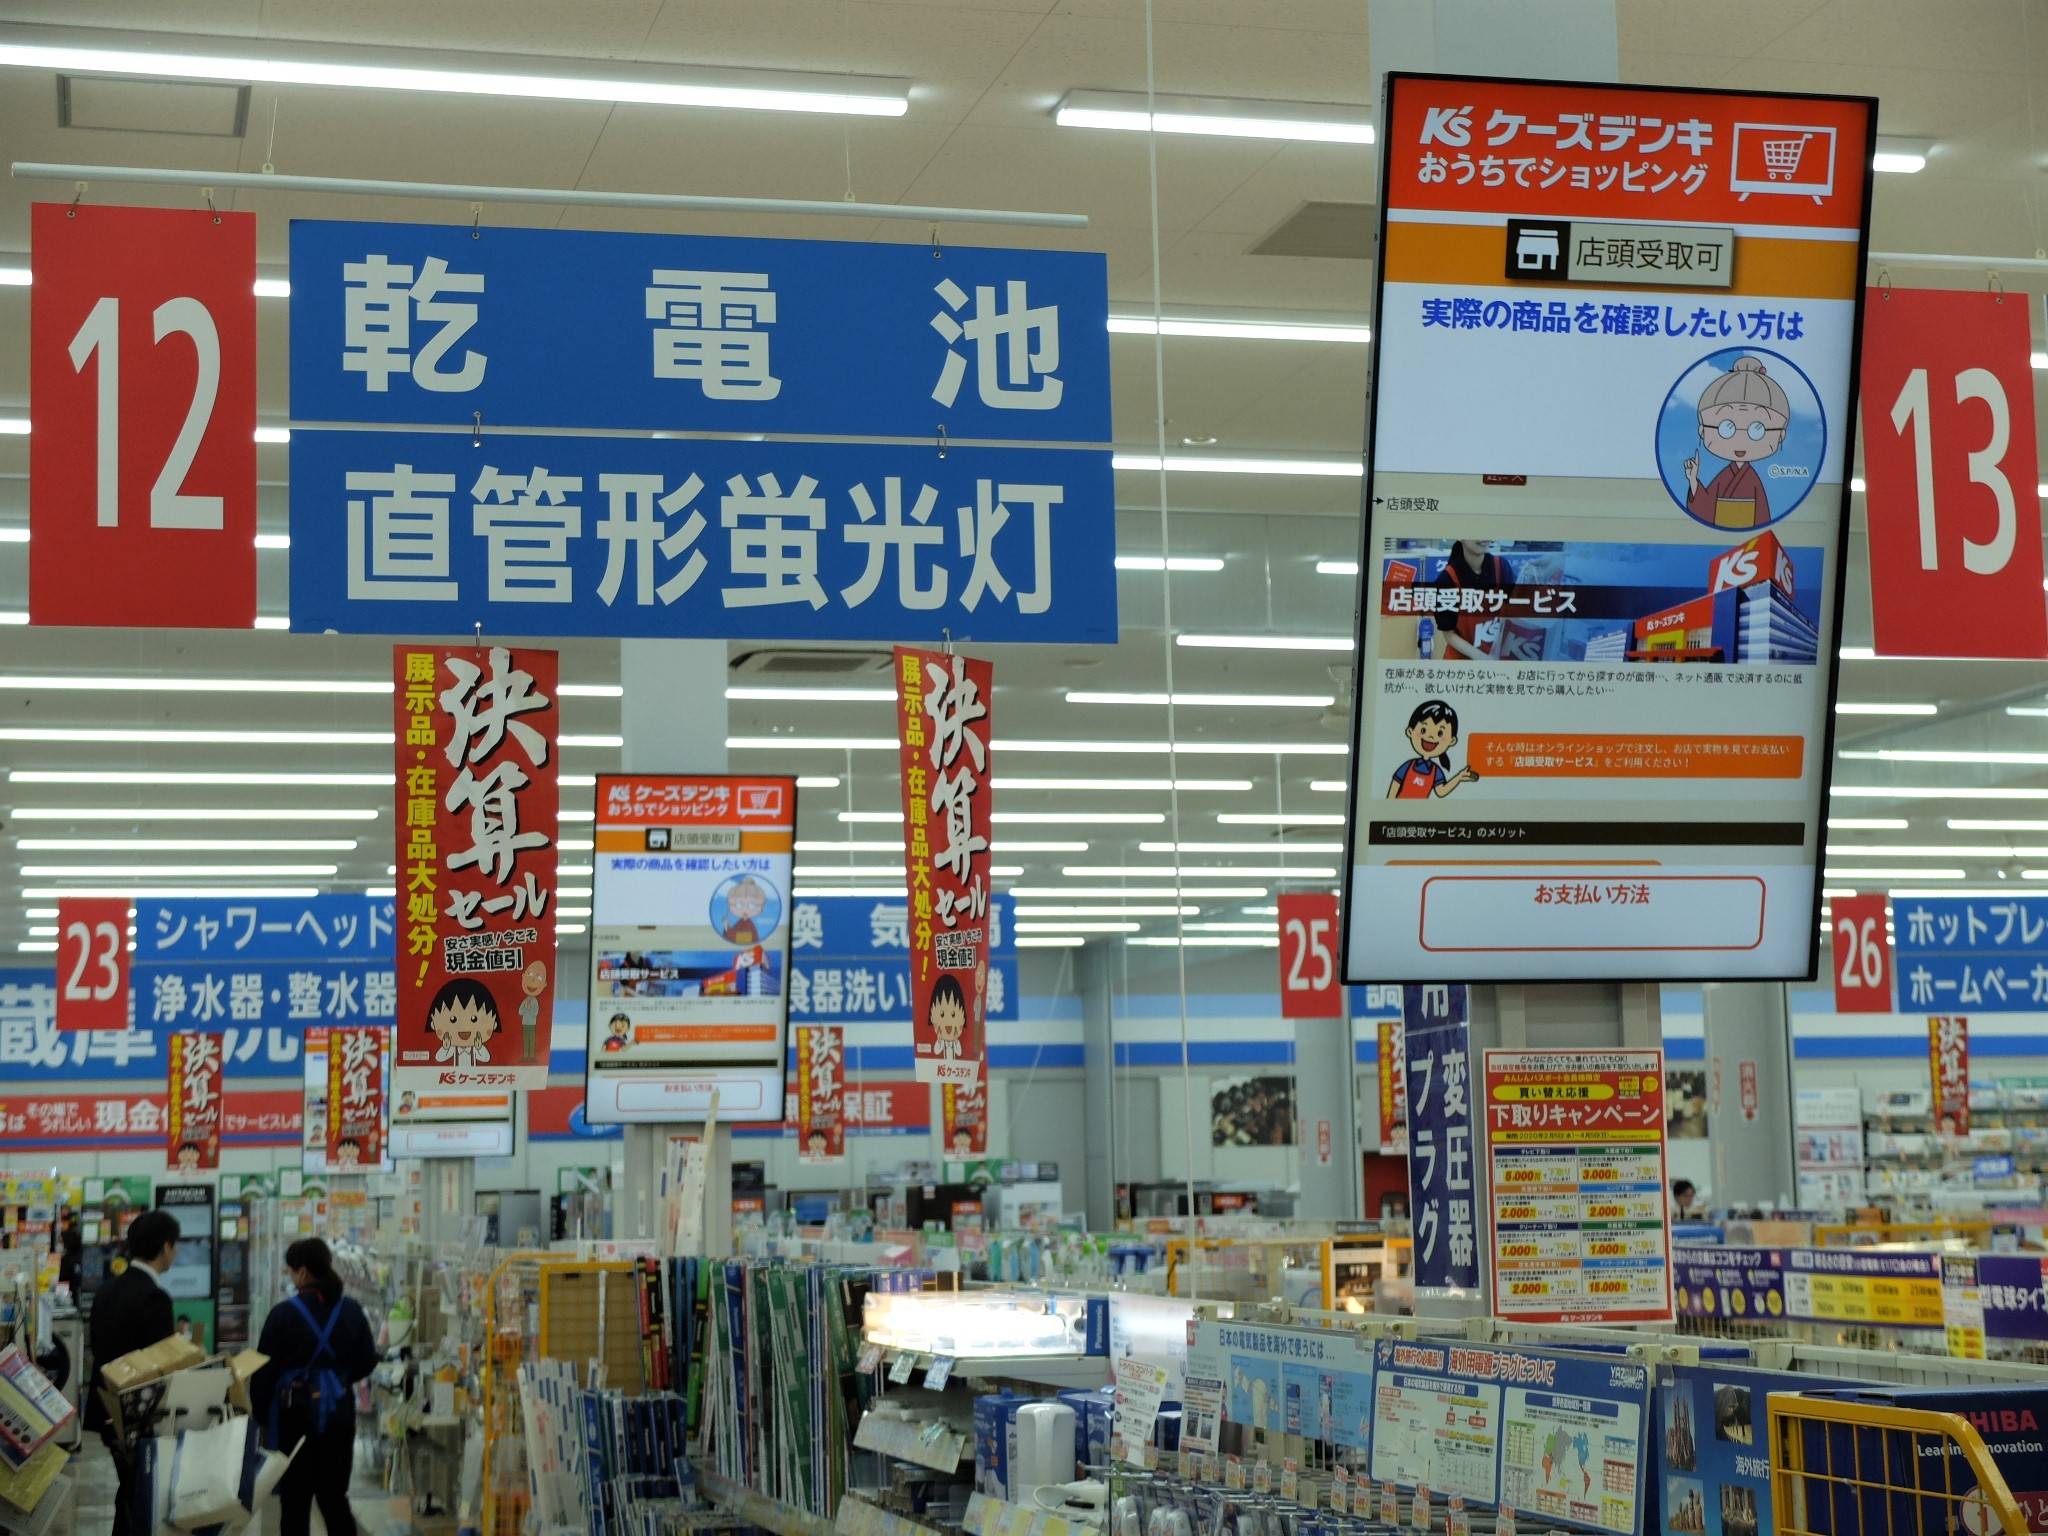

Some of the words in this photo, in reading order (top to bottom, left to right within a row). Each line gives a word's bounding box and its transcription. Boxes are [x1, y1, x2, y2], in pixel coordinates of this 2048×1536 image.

[1486, 110, 1713, 156] ケーズデンキ
[1418, 152, 1709, 196] おうちでショッピング
[1575, 236, 1724, 273] 店頭受取可
[1421, 297, 1804, 341] 実際の商品を確認したい方は
[67, 296, 224, 530] 12
[1890, 367, 2017, 575] 13
[1386, 496, 1439, 512] 店頭受取
[343, 463, 1064, 615] 直管形蛍光灯
[1388, 586, 1577, 614] 店頭受取サービス
[438, 646, 552, 886] 決算
[923, 656, 987, 887] 決算
[608, 803, 729, 817] おうちでショッピング
[635, 785, 731, 802] ケーズデンキ
[405, 652, 438, 988] 展示品・在庫品大処分！
[674, 833, 736, 846] 店頭受取可
[1381, 826, 1527, 839] 「店頭受取サービス」のメリット
[611, 858, 770, 871] 実際の商品を確認したい方は
[444, 872, 549, 931] セール
[934, 878, 987, 929] セール
[1534, 884, 1651, 905] お支払い方法
[156, 904, 396, 950] シャワーヘッド
[65, 921, 120, 1001] 23
[444, 947, 525, 973] 現金値引
[936, 946, 977, 970] 現金値引
[1285, 918, 1333, 991] 25
[1837, 916, 1883, 989] 26
[153, 970, 396, 1022] 浄水器・整水器
[458, 1073, 516, 1085] ケーズデンキ
[1519, 1086, 1590, 1098] 買い替え応援
[1489, 1103, 1661, 1128] 下取りキャンペーン
[1409, 1050, 1440, 1264] プラグ
[1441, 1047, 1473, 1267] 変圧器
[1448, 1349, 1557, 1386] 海外用電源プラグについて
[1735, 1454, 1770, 1480] 海外旅行
